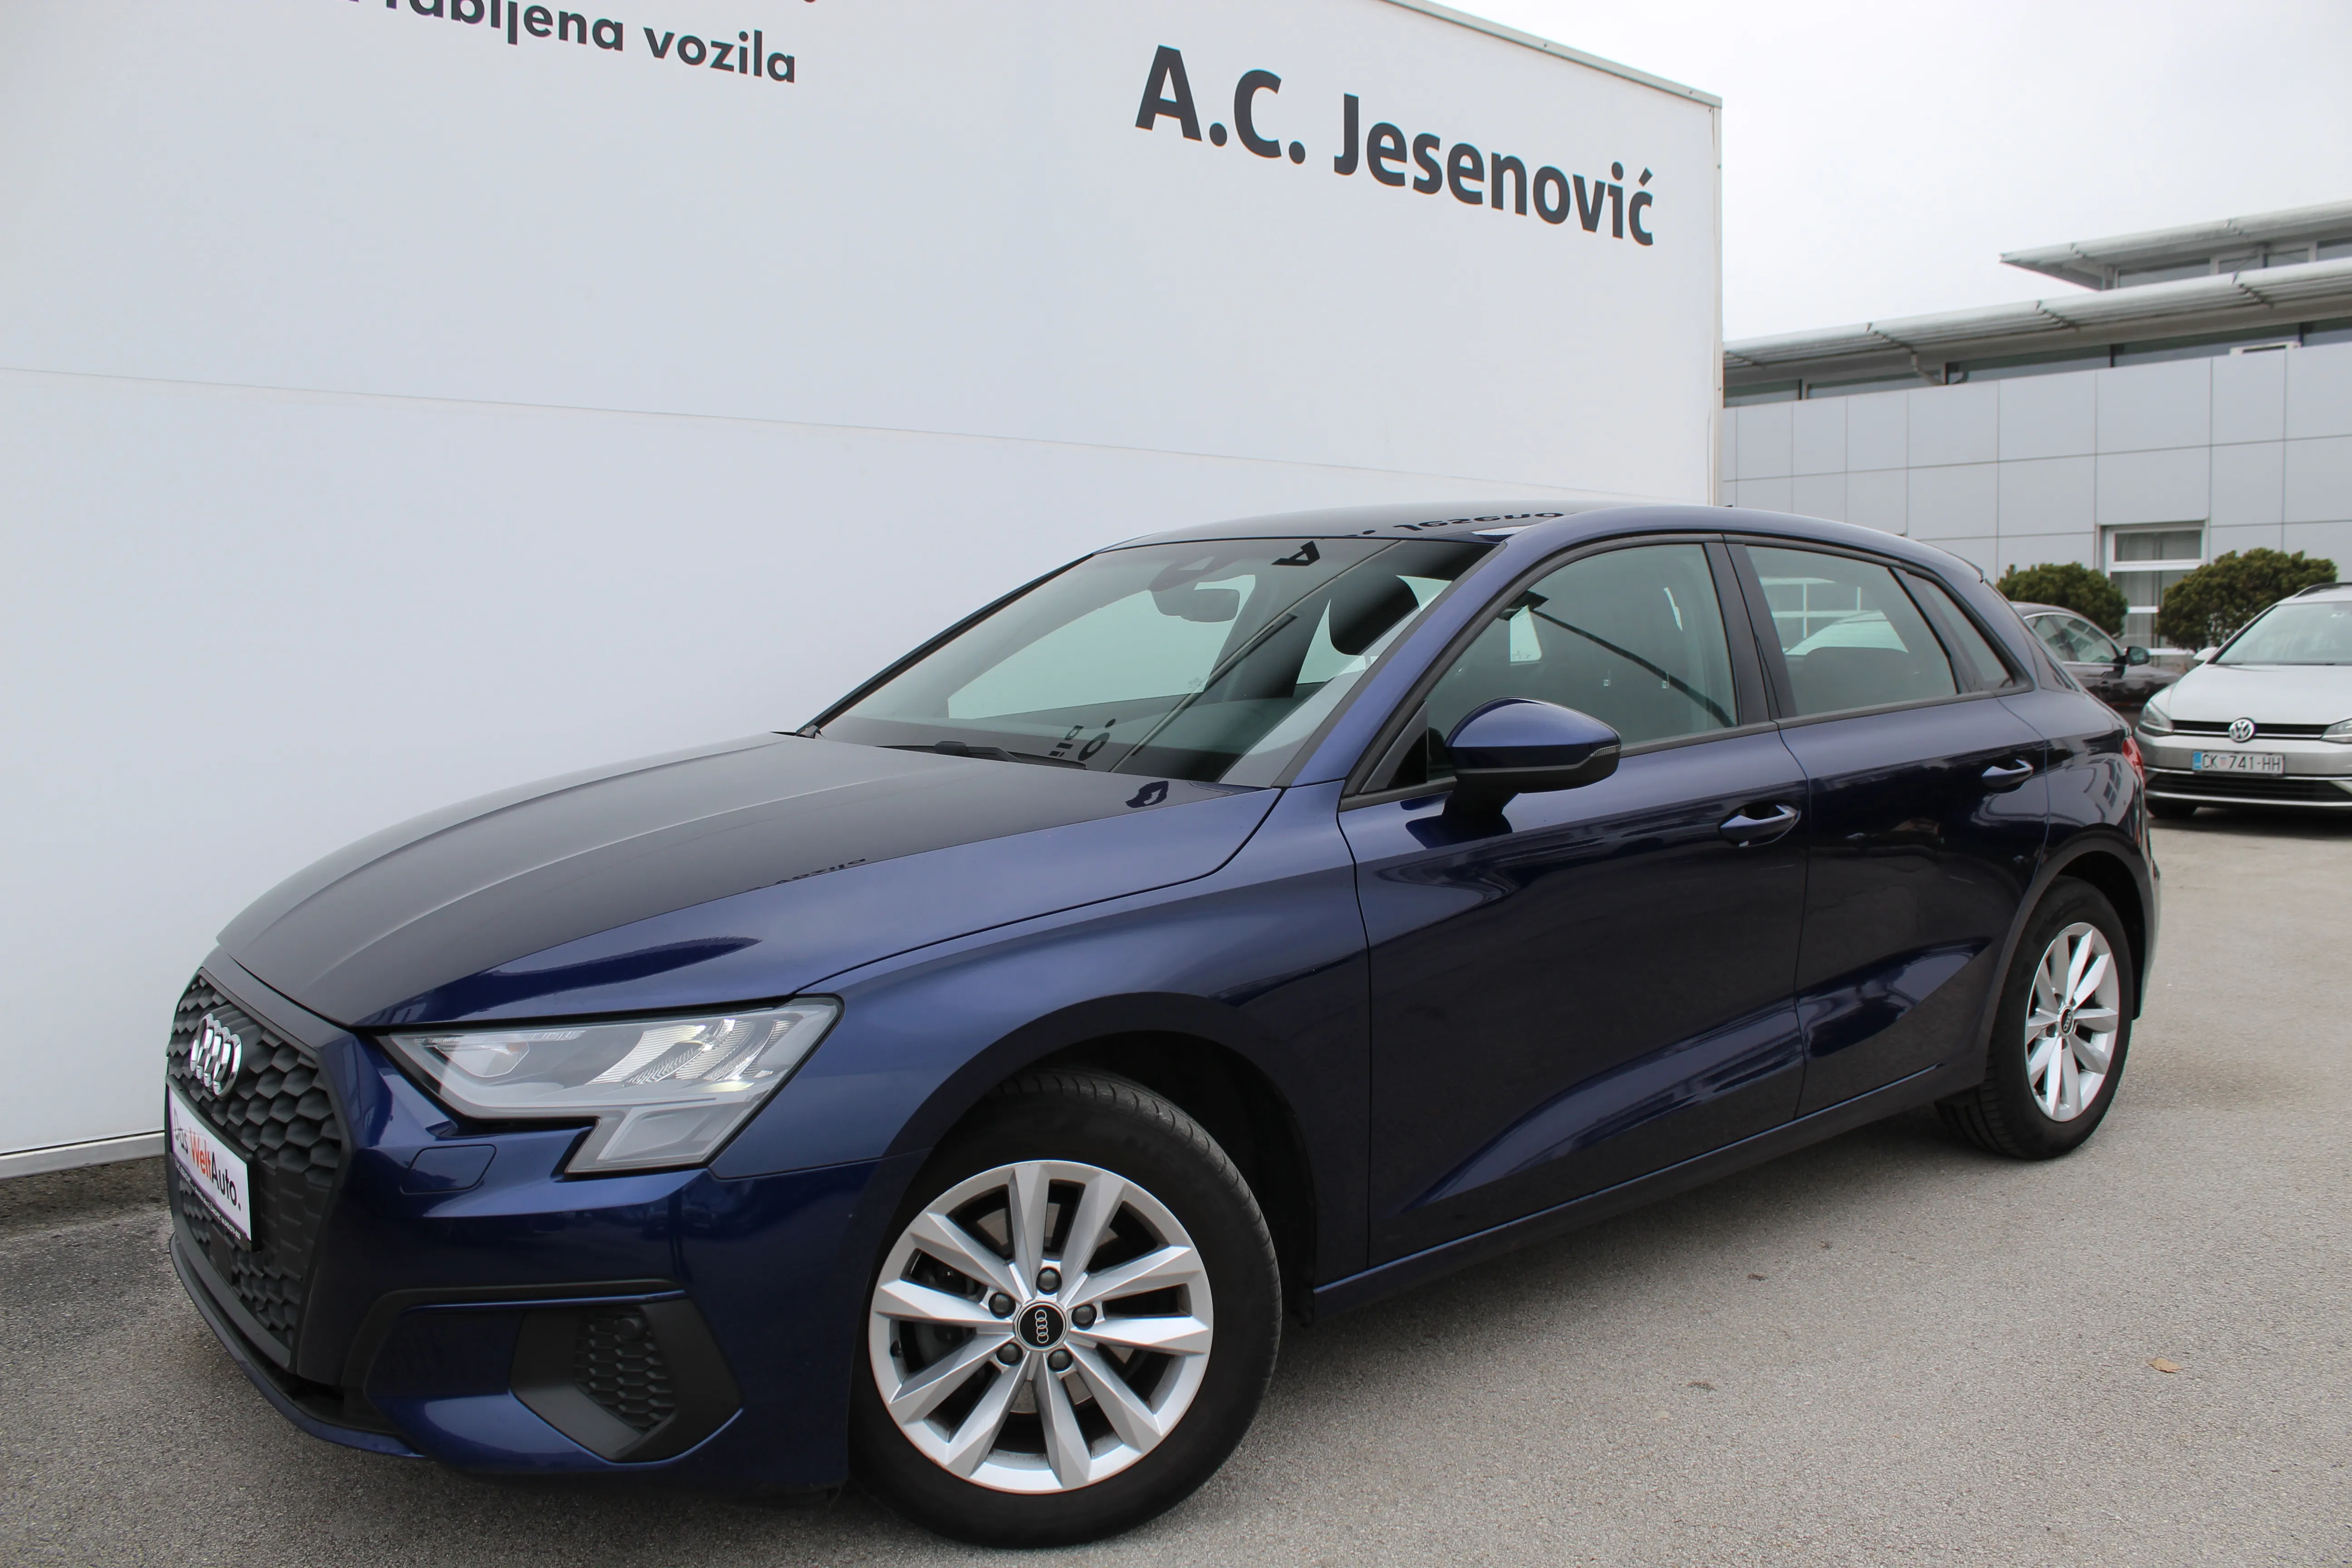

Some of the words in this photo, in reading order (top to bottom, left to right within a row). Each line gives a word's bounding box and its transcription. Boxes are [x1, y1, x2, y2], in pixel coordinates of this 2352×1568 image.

[643, 27, 795, 83] vozila
[1135, 44, 1306, 165] A.C.
[1334, 93, 1654, 246] Jesenović
[2203, 754, 2218, 769] CK
[189, 1127, 241, 1211] WeltAuto.
